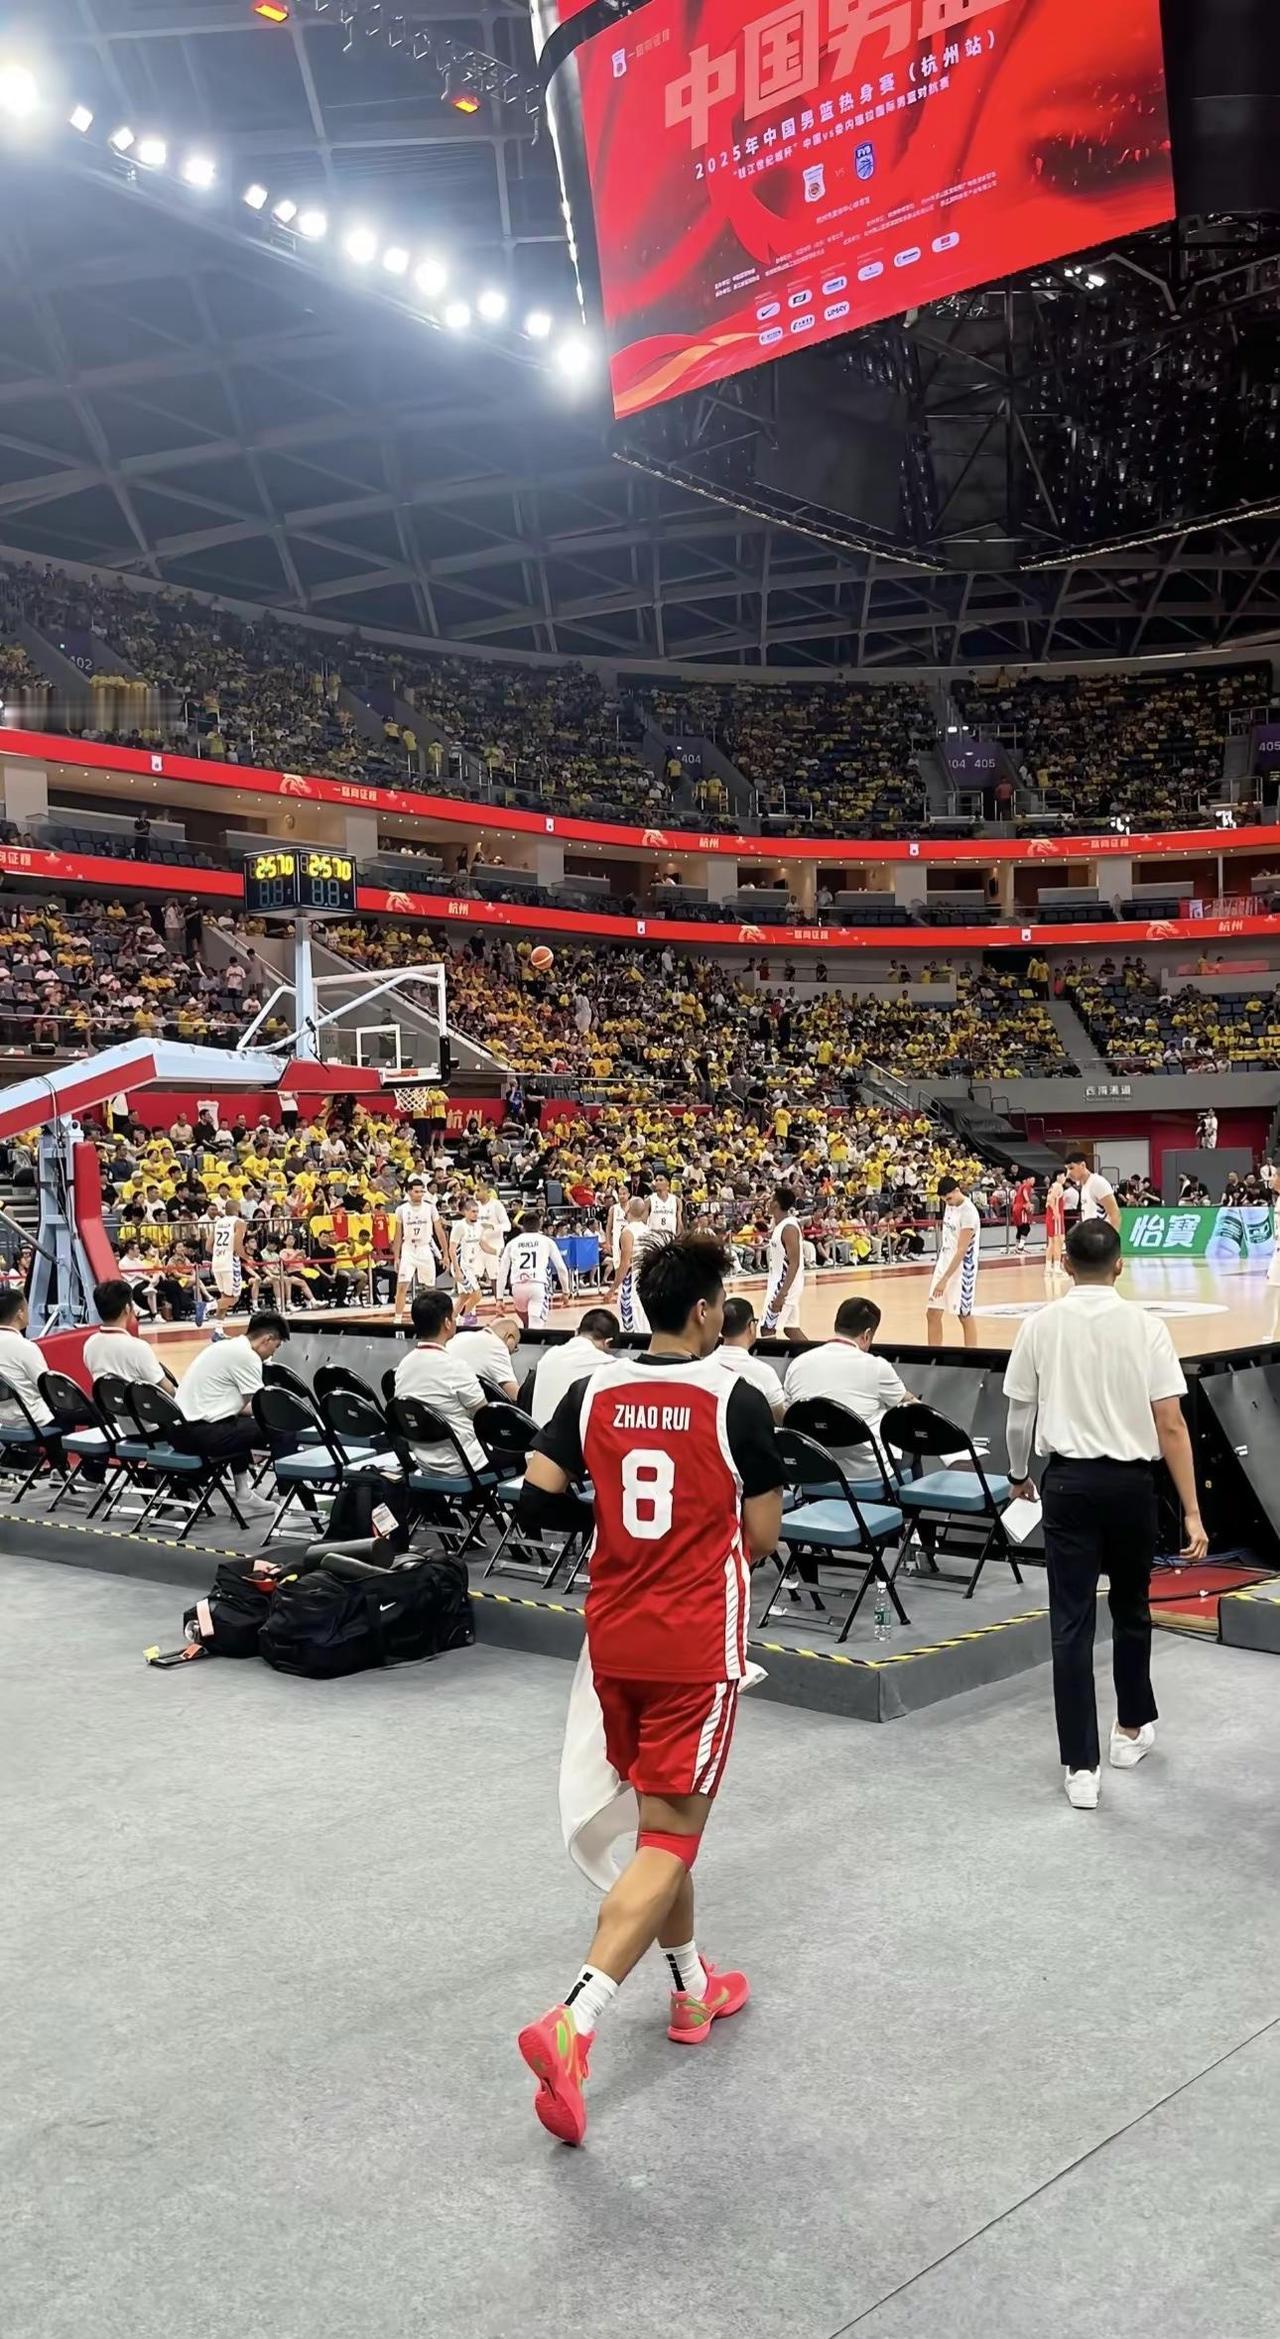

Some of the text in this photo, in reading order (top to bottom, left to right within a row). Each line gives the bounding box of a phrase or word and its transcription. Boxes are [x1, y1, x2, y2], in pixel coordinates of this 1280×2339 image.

[665, 0, 1008, 150] 中国男
[974, 759, 996, 768] 405
[216, 1231, 230, 1246] 22
[1129, 1213, 1201, 1248] 怡寶
[519, 1251, 537, 1270] 21
[613, 1404, 691, 1431] ZHAO RUI
[621, 1448, 675, 1540] 8
